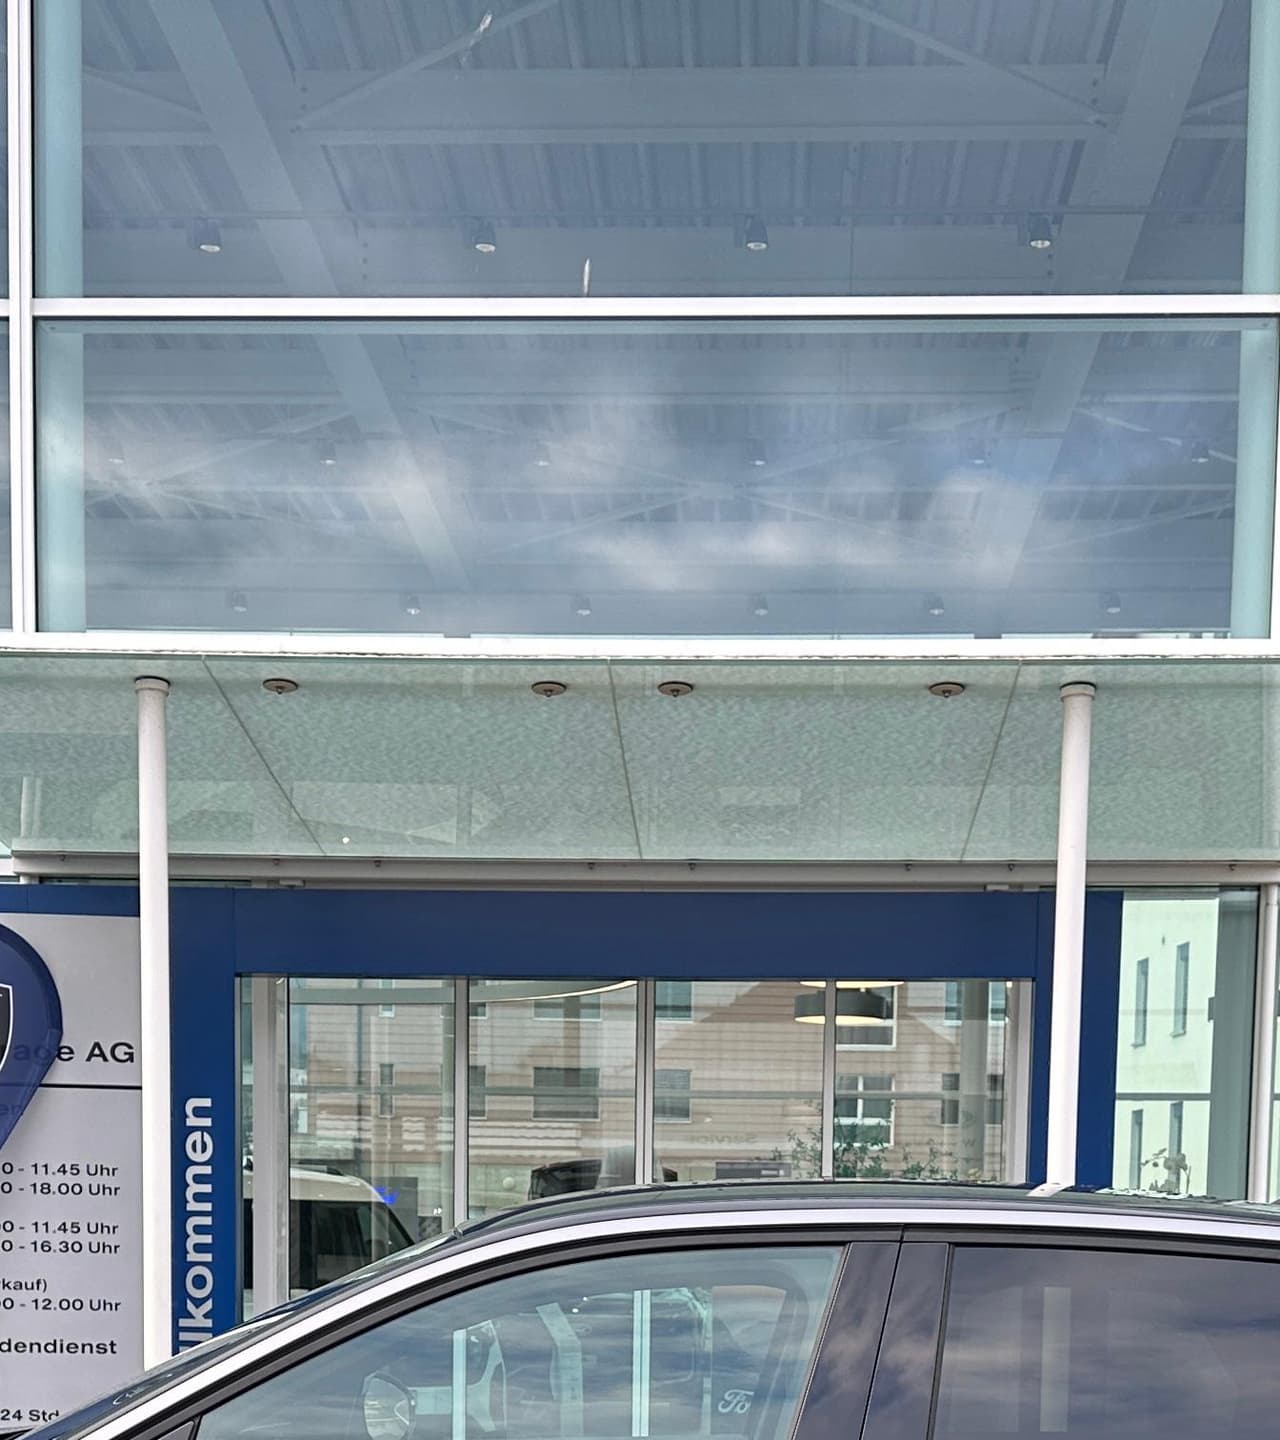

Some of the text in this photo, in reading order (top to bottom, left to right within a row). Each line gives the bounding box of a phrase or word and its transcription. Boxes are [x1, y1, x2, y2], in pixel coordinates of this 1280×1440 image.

[85, 1041, 135, 1064] AG
[31, 1163, 80, 1176] 11.45
[86, 1163, 119, 1177] Uhr
[30, 1183, 83, 1196] 18.00
[88, 1183, 121, 1197] Uhr
[31, 1220, 81, 1234] 11.45
[86, 1221, 119, 1235] Uhr
[178, 1097, 215, 1353] lkommen
[30, 1240, 83, 1254] 16.30
[88, 1241, 121, 1254] Uhr
[31, 1298, 84, 1311] 12.00
[89, 1298, 121, 1312] Uhr
[0, 1409, 23, 1421] 24
